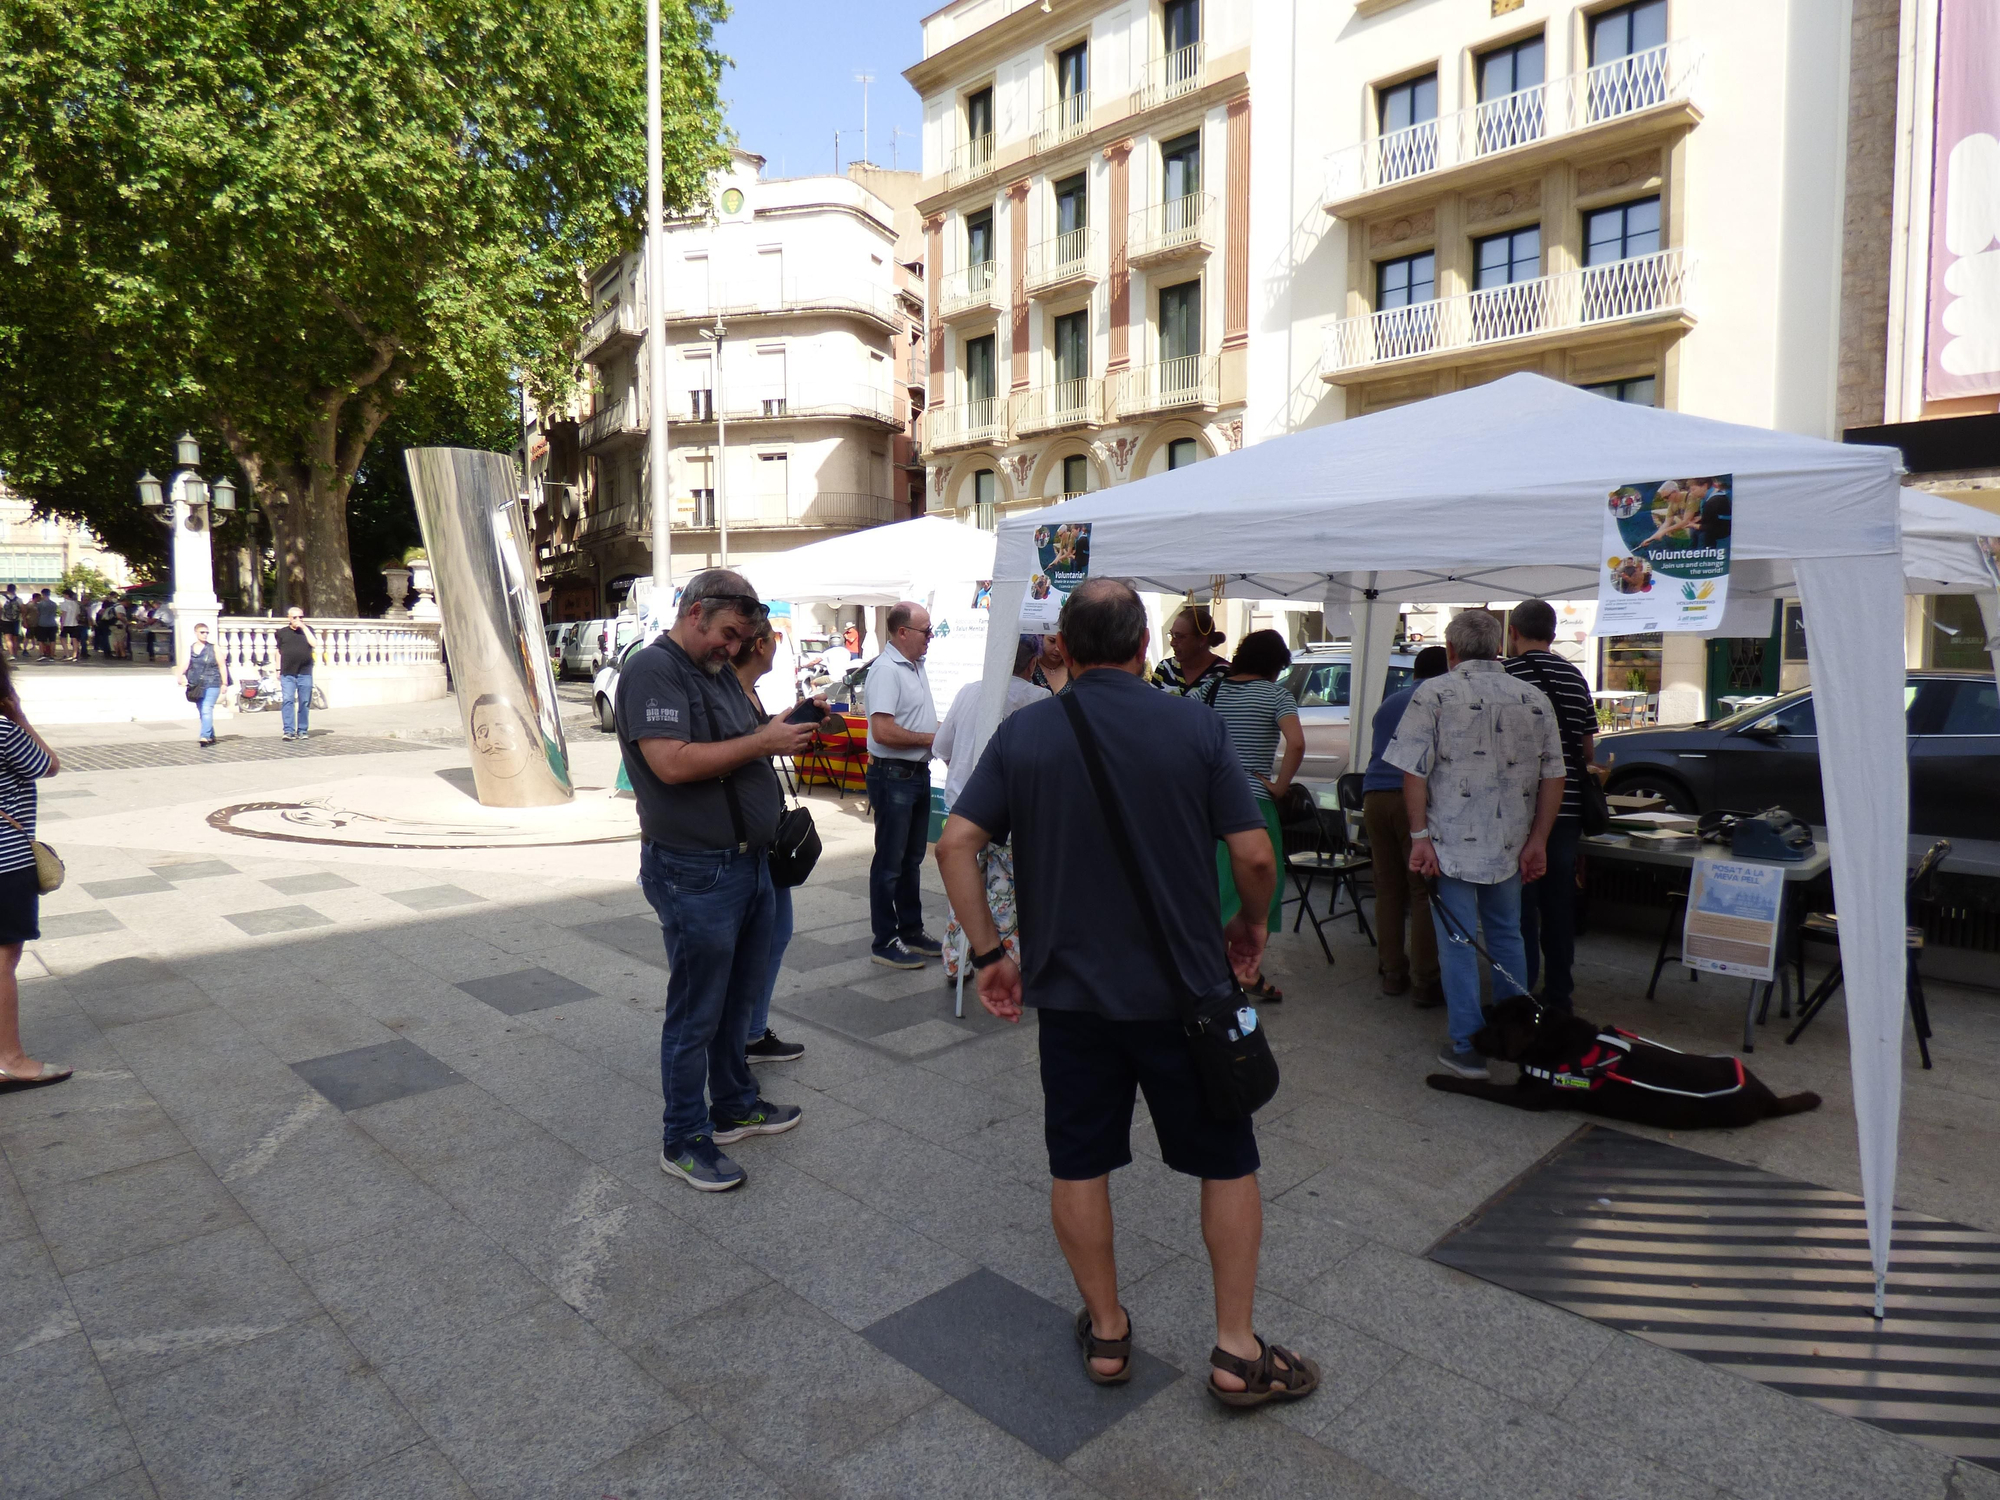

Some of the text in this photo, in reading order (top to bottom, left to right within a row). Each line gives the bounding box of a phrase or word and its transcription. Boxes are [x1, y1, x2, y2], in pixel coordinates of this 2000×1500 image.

[1648, 546, 1725, 561] Volunteering
[1698, 560, 1724, 568] change
[1702, 567, 1724, 575] world!
[660, 708, 679, 717] FOOT
[1711, 864, 1743, 875] POSA'T
[1753, 869, 1765, 877] LA
[1713, 872, 1760, 885] MEVA PELL
